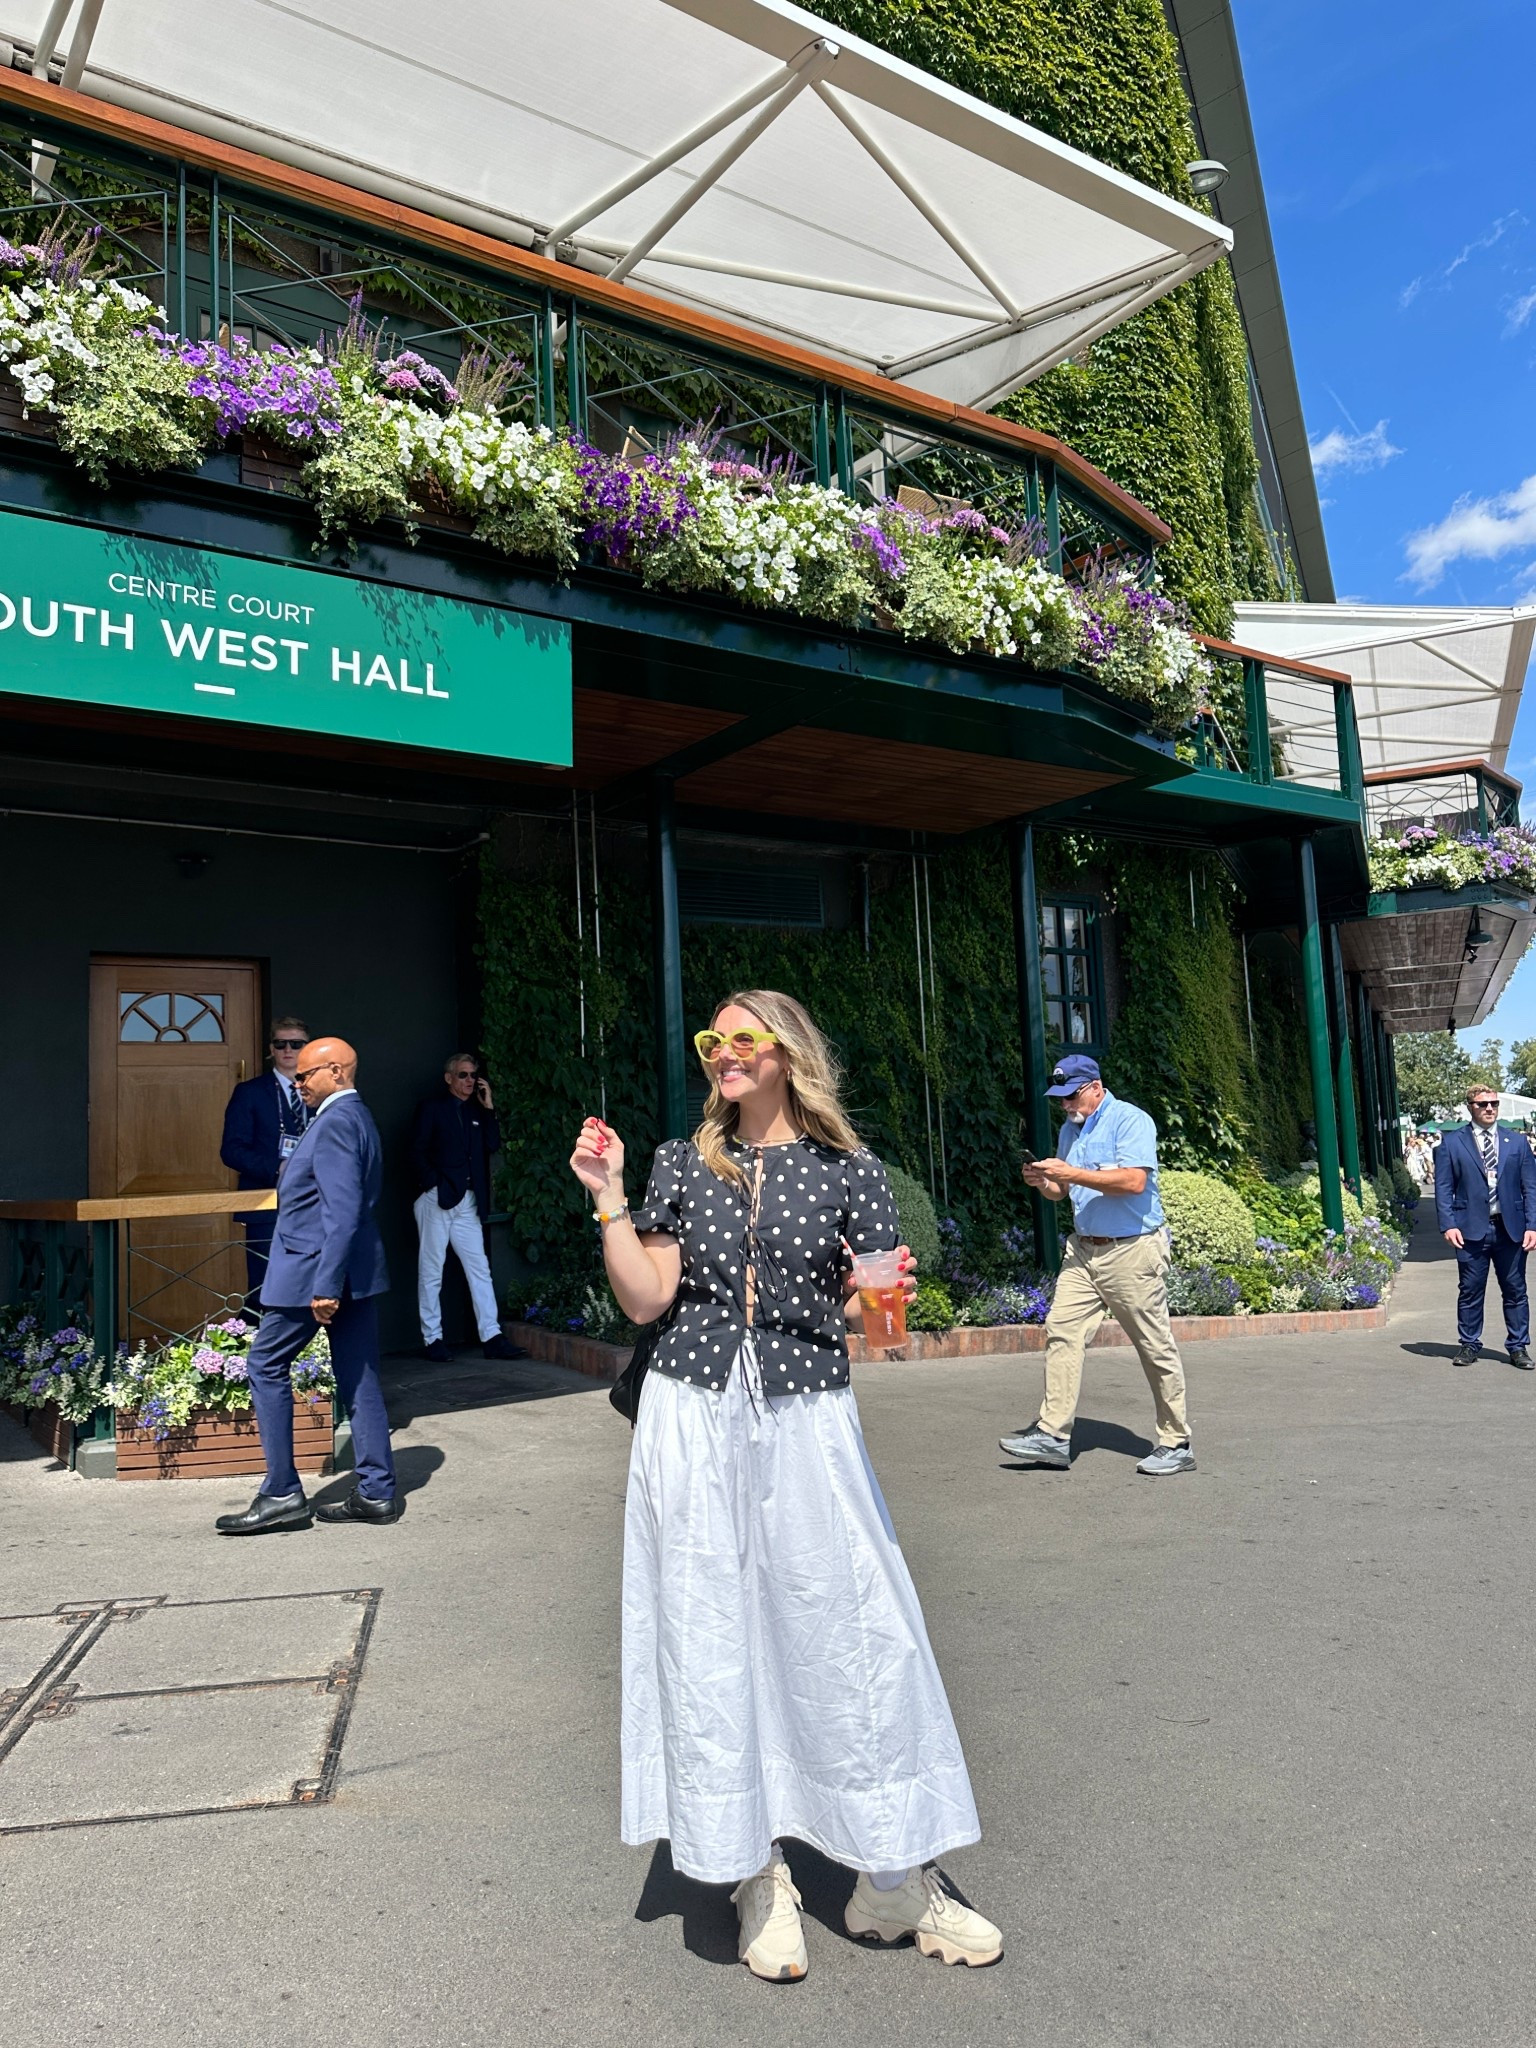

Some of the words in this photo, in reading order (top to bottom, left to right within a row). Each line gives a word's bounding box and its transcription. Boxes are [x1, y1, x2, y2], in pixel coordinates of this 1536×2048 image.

[109, 573, 216, 609] CENTRE
[228, 594, 315, 625] COURT
[161, 620, 309, 675] WEST
[332, 647, 450, 699] HALL
